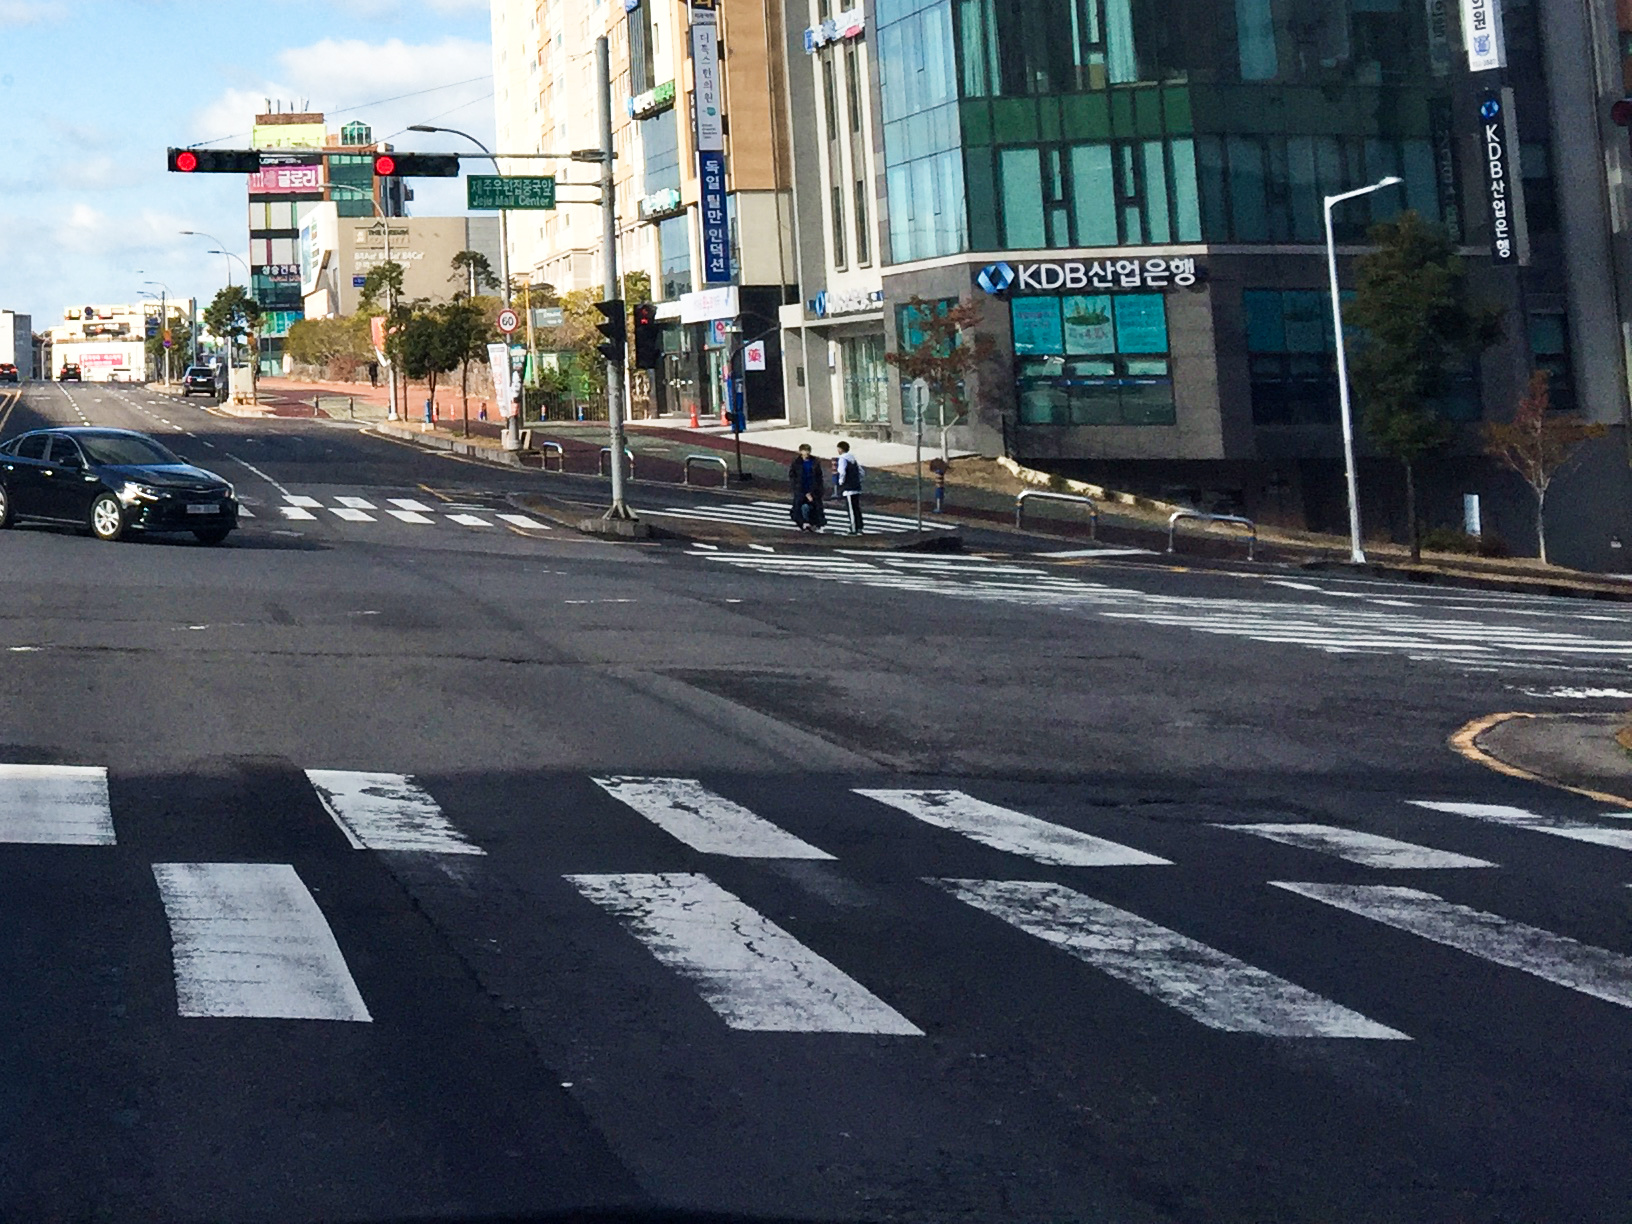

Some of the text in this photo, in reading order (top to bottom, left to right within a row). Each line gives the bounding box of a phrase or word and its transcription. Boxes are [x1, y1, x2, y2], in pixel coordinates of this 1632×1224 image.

[278, 170, 316, 187] 글로리
[705, 160, 721, 190] 독일
[471, 179, 552, 196] 제주우편집중국앞
[1486, 124, 1510, 258] KDB산업은행
[518, 195, 550, 206] Center
[709, 229, 725, 272] 인덕션
[1018, 258, 1196, 290] KDB산업은행
[501, 316, 514, 326] 60
